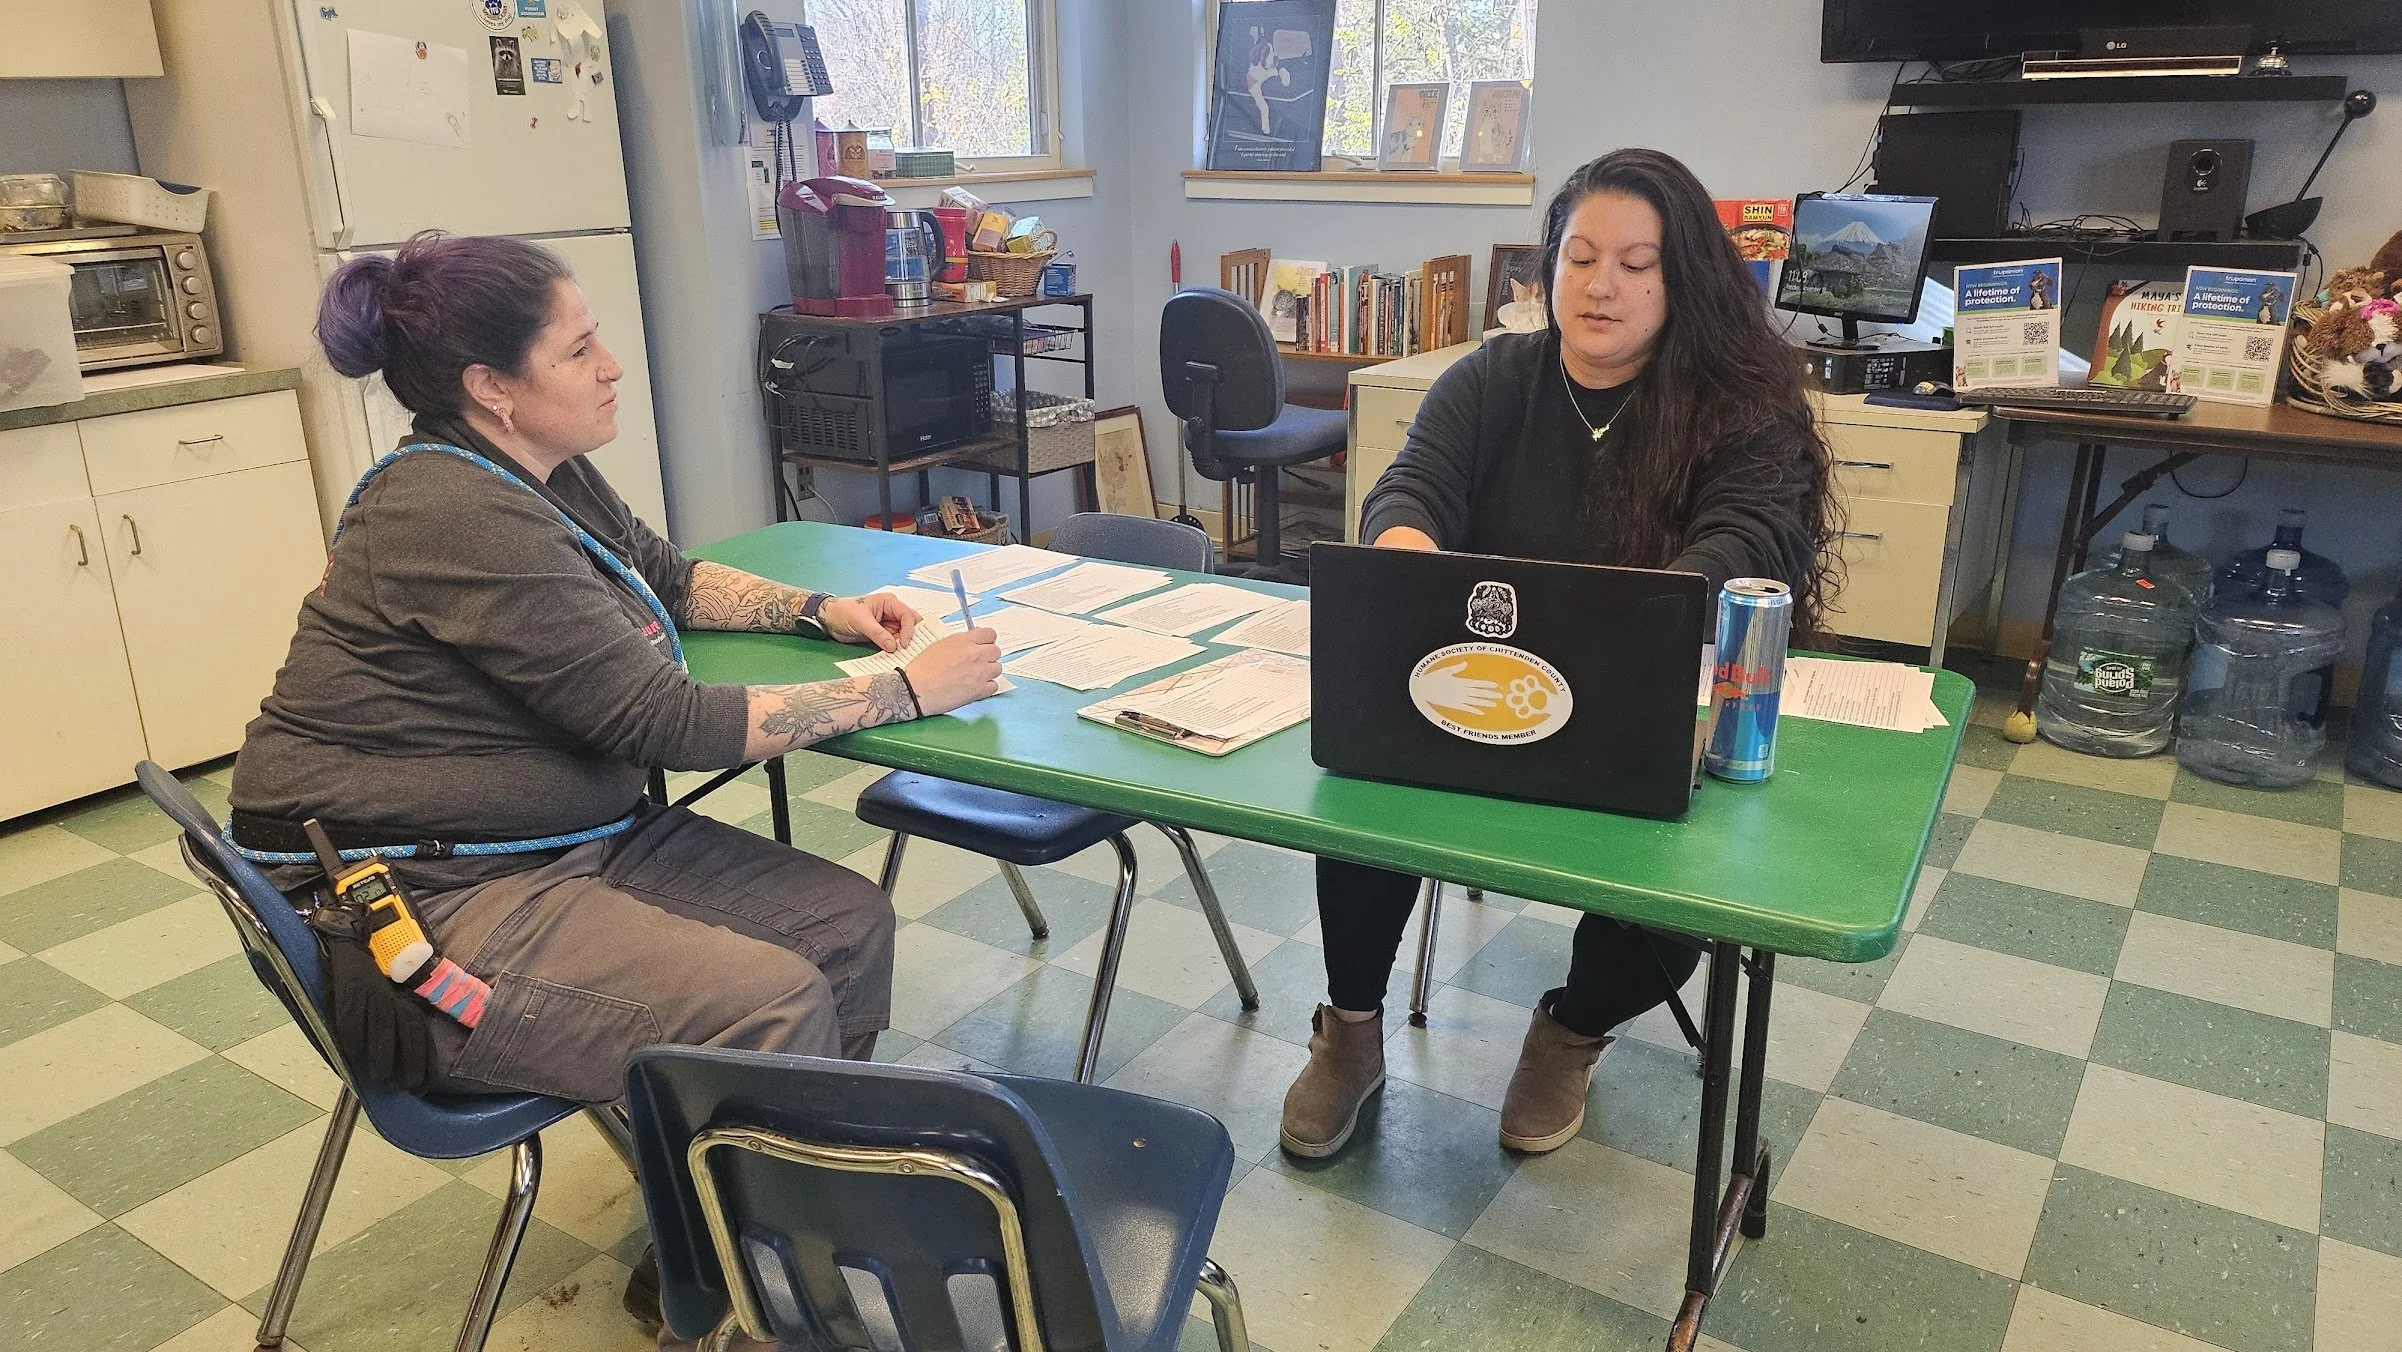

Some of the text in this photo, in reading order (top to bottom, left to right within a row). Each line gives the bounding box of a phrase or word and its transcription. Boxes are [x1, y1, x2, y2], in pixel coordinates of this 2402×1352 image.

[1744, 205, 1773, 215] SHIN
[1993, 268, 2024, 276] trupanion
[2225, 275, 2257, 283] trupanion
[1974, 288, 2008, 297] lifetime
[2010, 286, 2021, 295] of
[2141, 291, 2182, 301] MAYA'S
[1965, 295, 2017, 307] protection.
[2193, 292, 2251, 305] A lifetime of
[2130, 302, 2181, 313] HIKING TRI
[2192, 300, 2245, 312] protection.
[1414, 654, 1441, 678] HUMANE
[1441, 645, 1474, 657] SOCIETY
[1489, 646, 1540, 666] CHITTENDEN
[1541, 665, 1566, 692] COUNTY
[1712, 662, 1769, 684] ed Bull
[2094, 667, 2135, 680] Spring
[2094, 678, 2135, 689] Poland
[1441, 719, 1537, 740] BEST FRIENDS MEMBER
